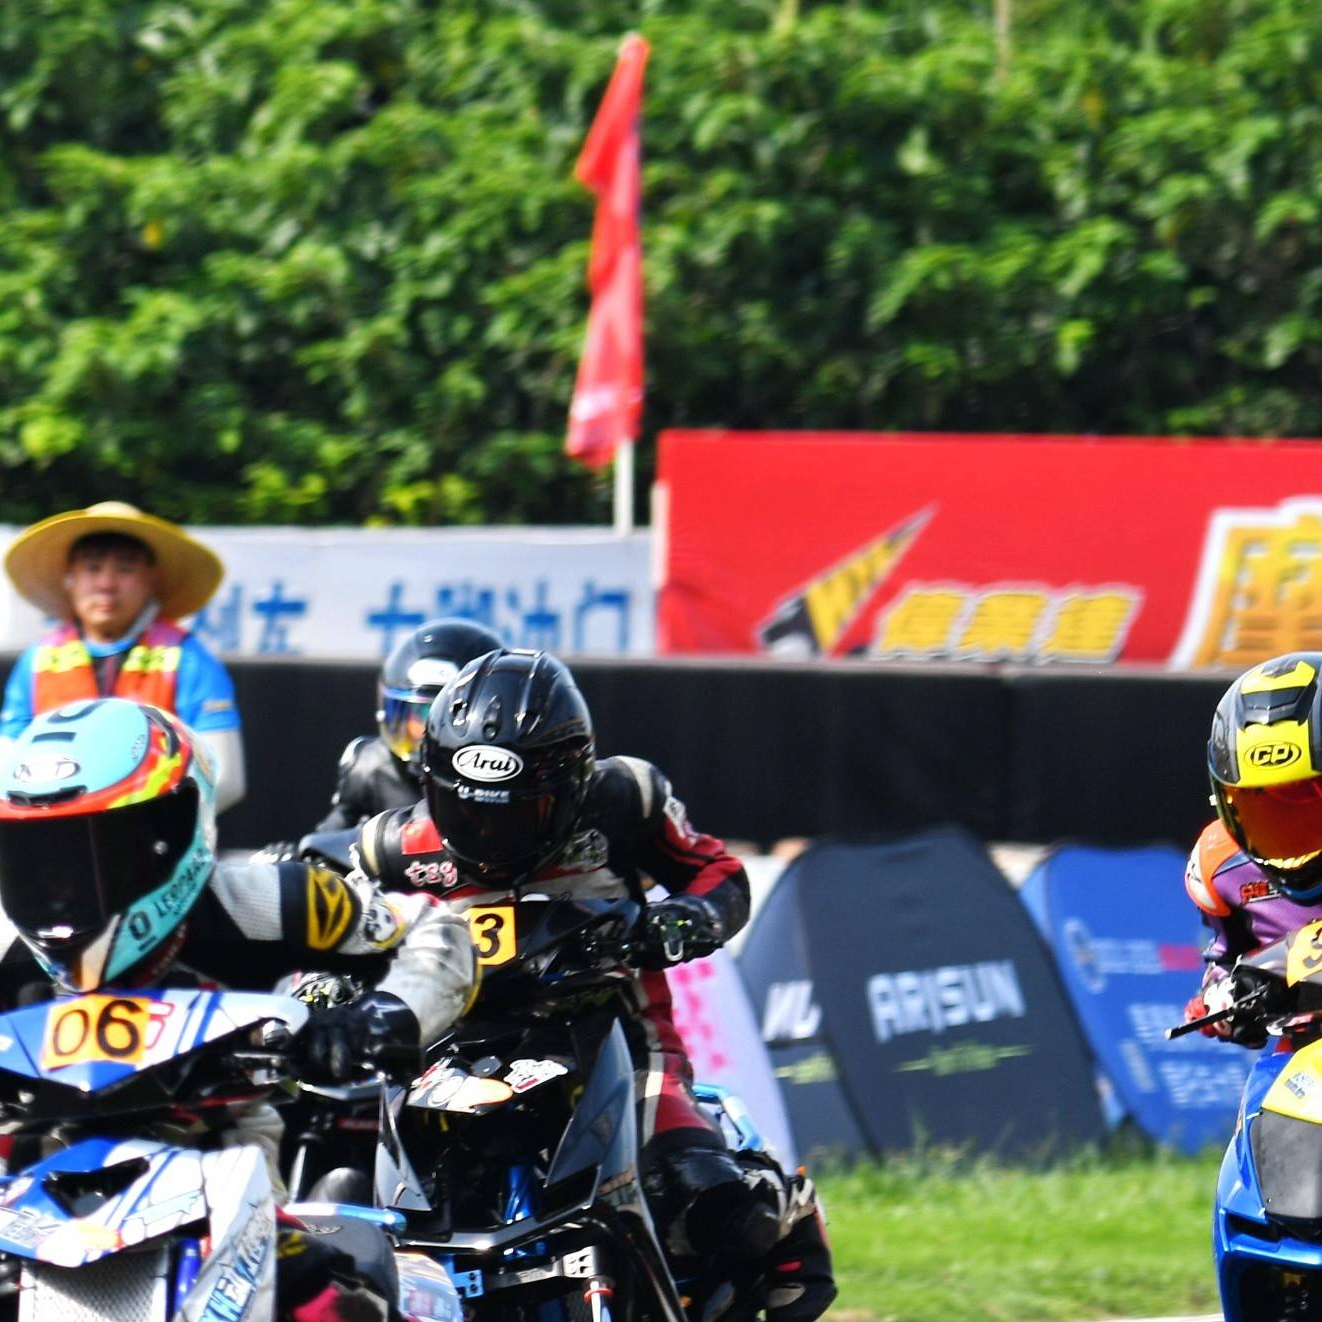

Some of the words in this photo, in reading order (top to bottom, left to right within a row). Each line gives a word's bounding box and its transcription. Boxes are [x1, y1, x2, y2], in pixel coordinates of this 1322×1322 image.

[466, 750, 515, 773] Arai
[52, 999, 141, 1058] 06
[867, 958, 1026, 1043] ARISUN
